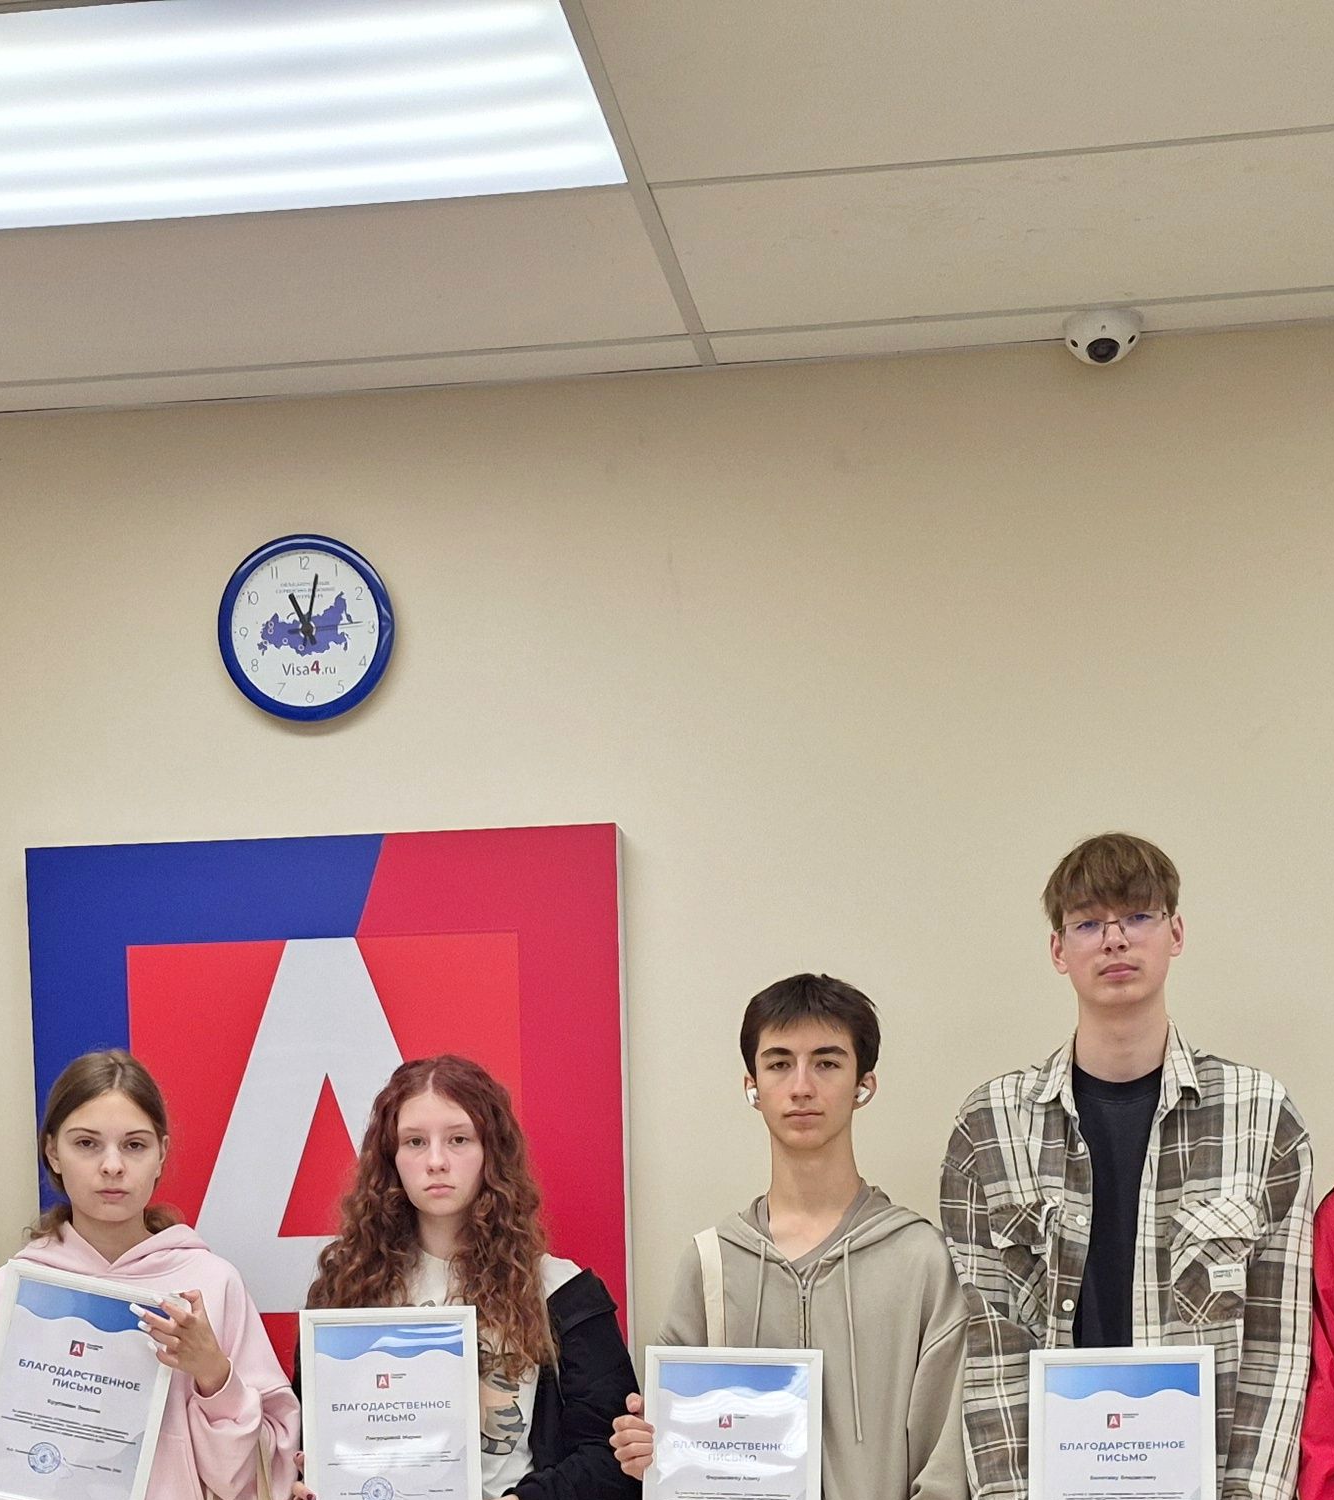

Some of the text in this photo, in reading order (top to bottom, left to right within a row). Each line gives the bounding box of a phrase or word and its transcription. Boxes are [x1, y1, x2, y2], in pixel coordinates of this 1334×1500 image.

[299, 556, 309, 570] 12
[271, 566, 278, 579] 11
[335, 564, 338, 576] 1
[248, 591, 258, 605] 10
[355, 587, 363, 600] 2
[239, 627, 248, 639] 9
[368, 621, 375, 633] 3
[251, 659, 258, 672] 8
[359, 656, 367, 666] 4
[282, 660, 336, 676] Visa4.ru
[277, 682, 286, 696] 7
[337, 681, 344, 693] 5
[306, 690, 314, 703] 6
[18, 1358, 141, 1392] БЛАГОДАРСТВЕННОЕ
[52, 1377, 102, 1395] ПИСЬМО
[332, 1400, 452, 1412] БЛАГОДАРСТВЕННОЕ
[367, 1413, 416, 1423] ПИСЬМО
[1059, 1440, 1186, 1451] БЛАГОДАРСТВЕННОЕ
[1096, 1453, 1148, 1463] ПИСЬМО
